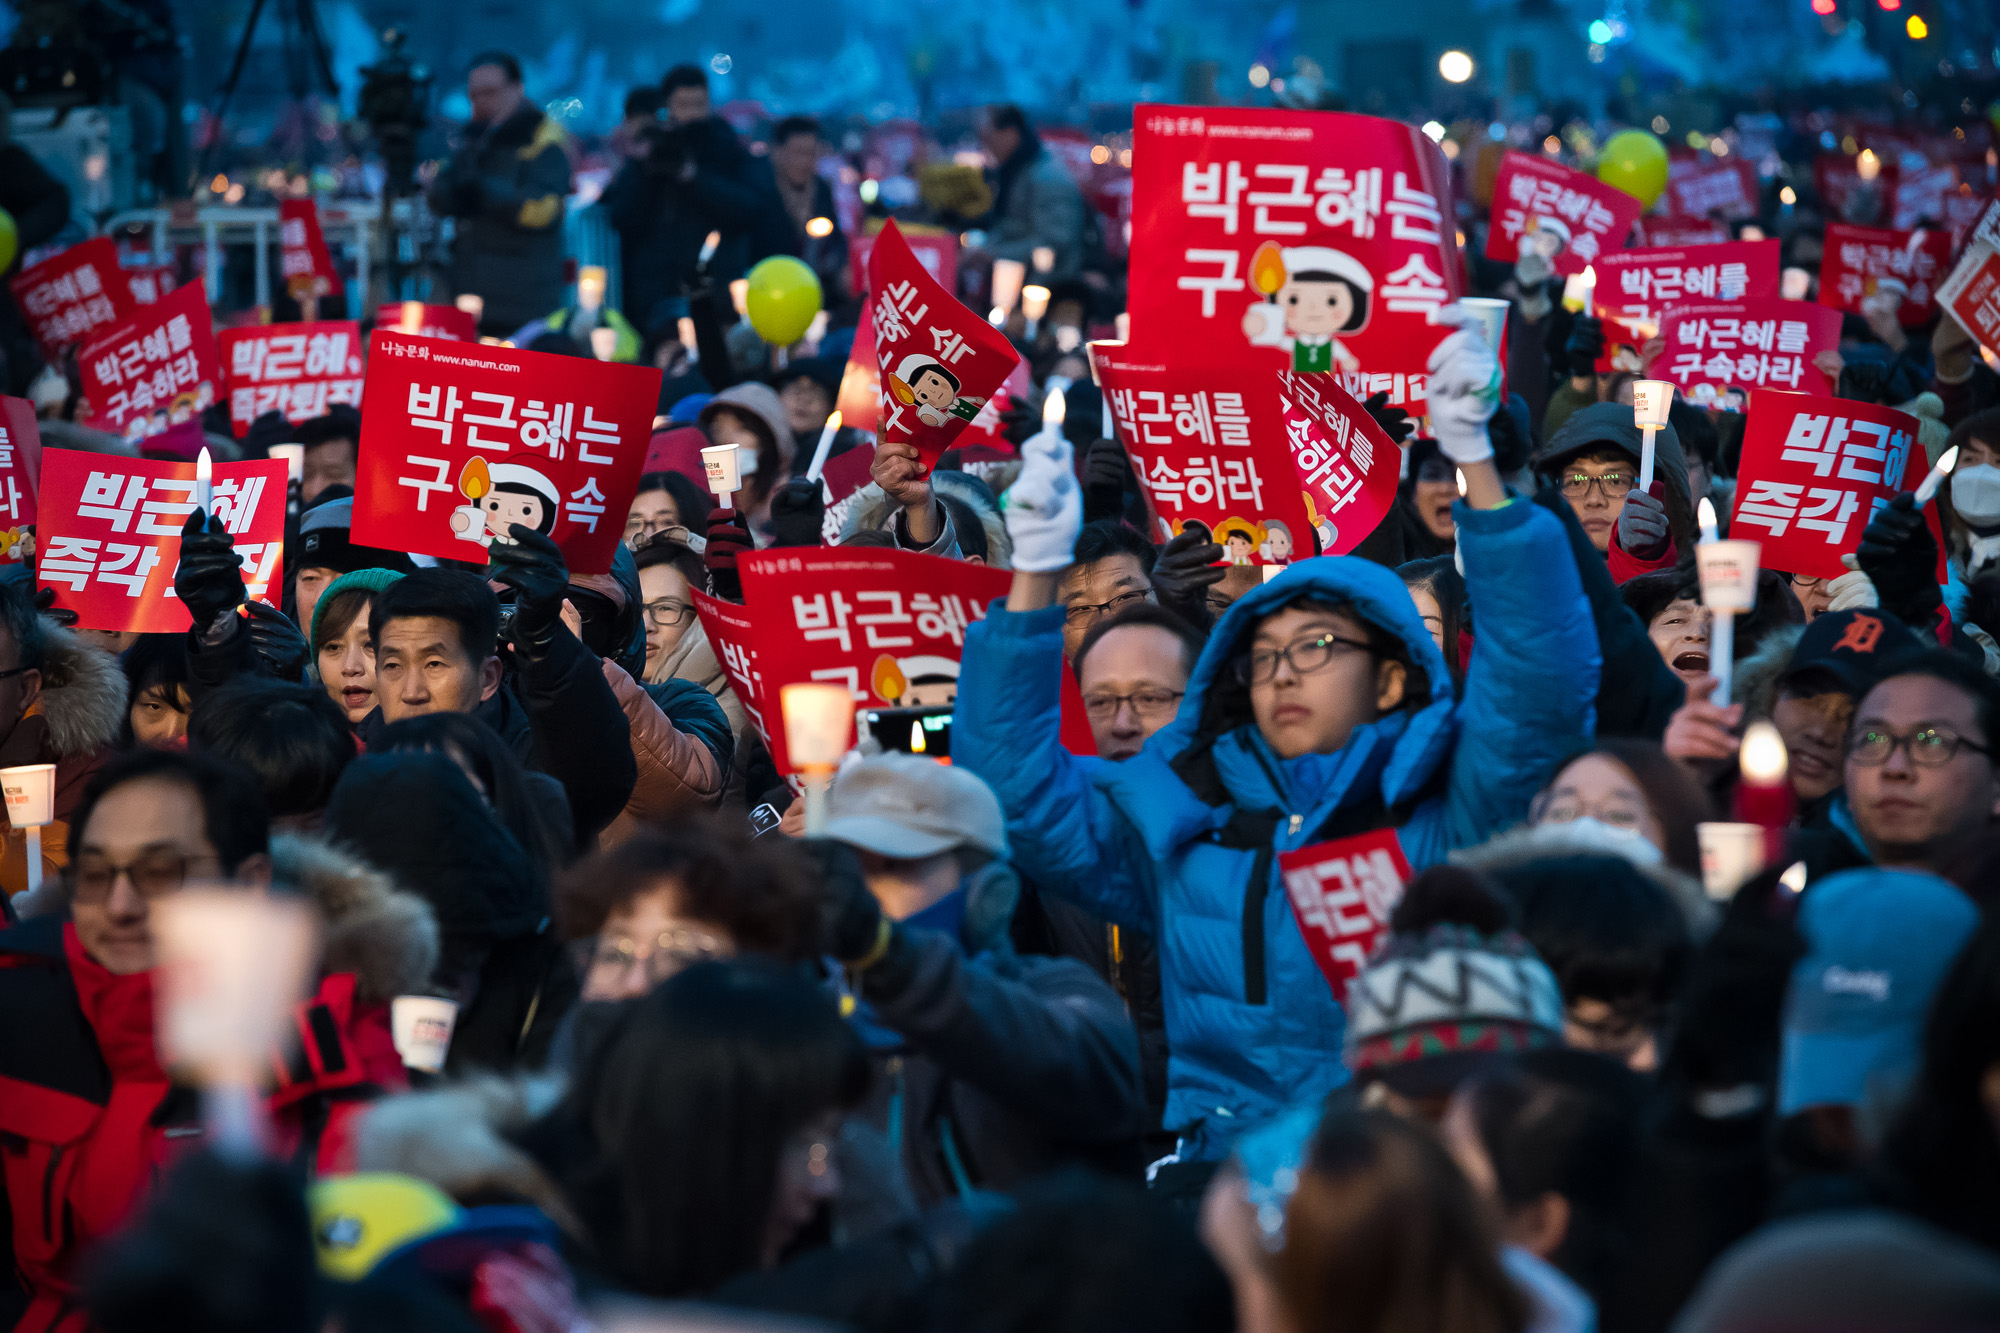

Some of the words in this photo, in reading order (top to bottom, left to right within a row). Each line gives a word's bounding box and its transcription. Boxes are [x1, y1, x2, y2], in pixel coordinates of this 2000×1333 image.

[1182, 160, 1443, 245] 박근혜는
[1509, 173, 1615, 235] 박근혜는
[1621, 262, 1749, 301] 박근혜를
[95, 313, 193, 386] 박근혜를
[381, 341, 430, 360] 나눔문화
[432, 353, 521, 373] www.nanum.com
[1678, 318, 1811, 354] 박근혜를
[106, 350, 200, 427] 구속하라
[1670, 351, 1805, 389] 구속하라
[407, 383, 622, 465] 박근혜는
[1110, 388, 1251, 447] 박근혜를
[1279, 393, 1364, 515] 속하라
[1780, 412, 1913, 493] 박근혜
[77, 471, 267, 536] 박근혜
[1735, 479, 1888, 546] 즉각
[39, 536, 284, 598] 즉각진
[792, 591, 987, 652] 박근혜
